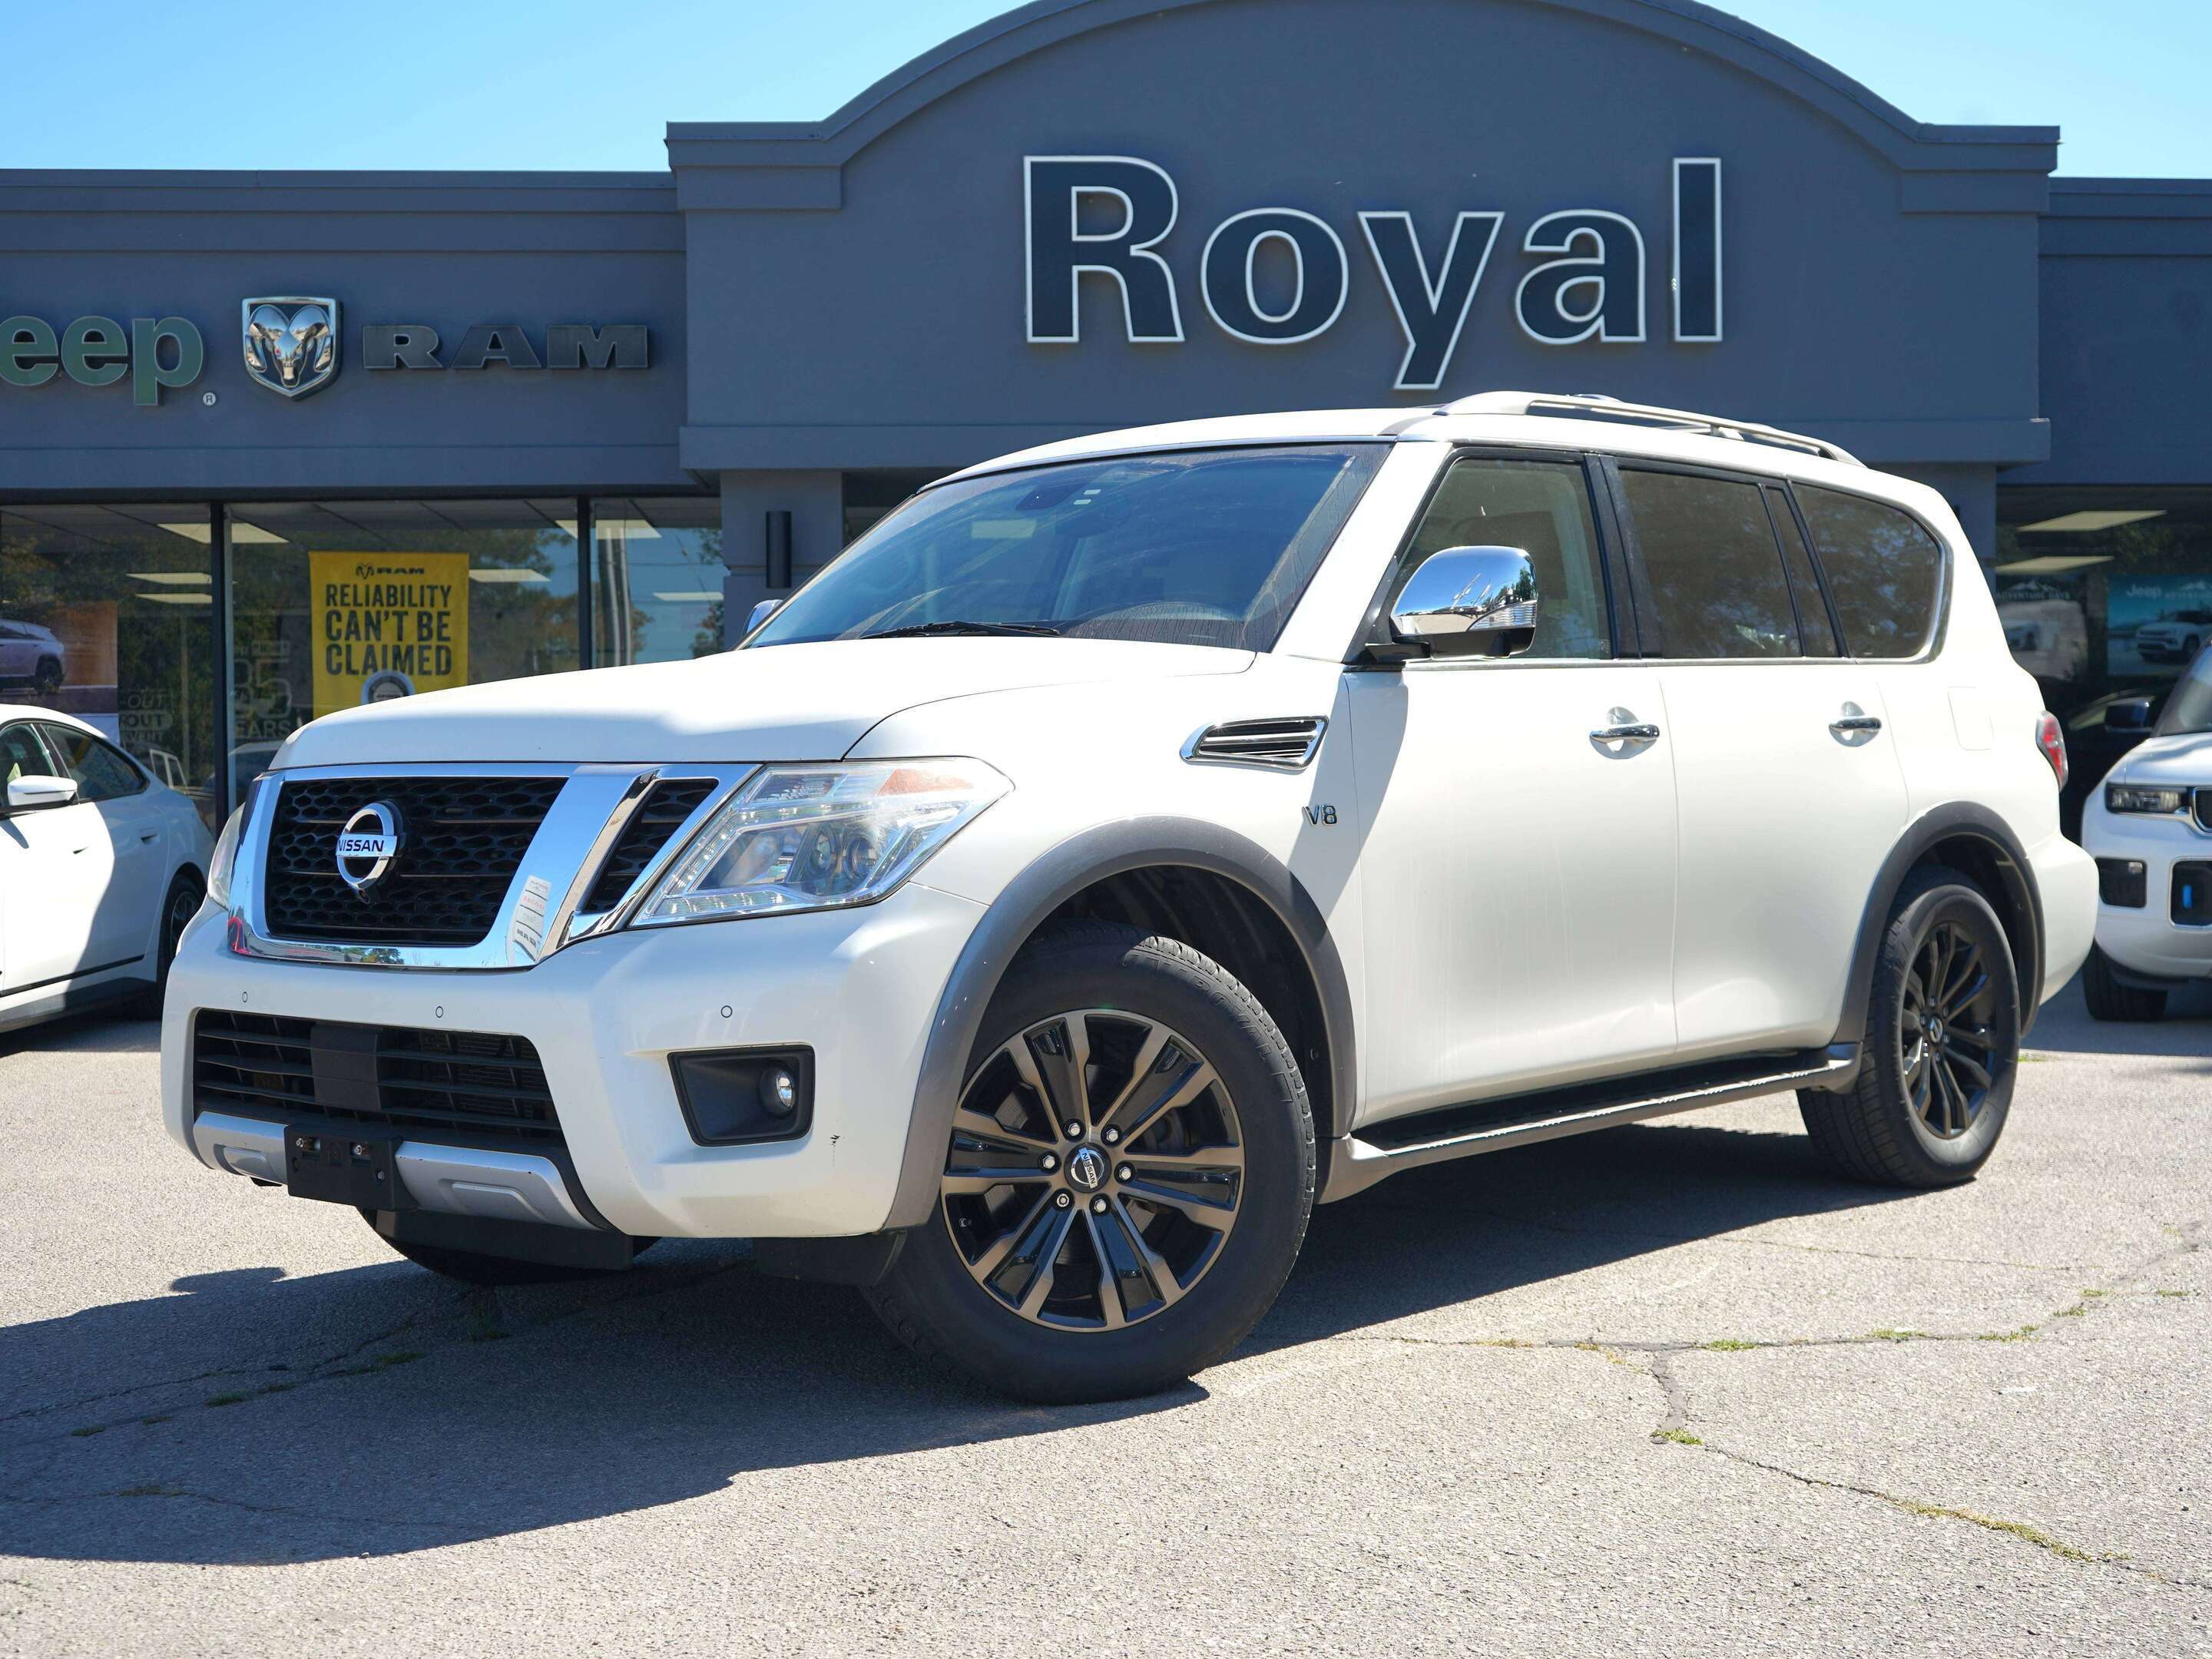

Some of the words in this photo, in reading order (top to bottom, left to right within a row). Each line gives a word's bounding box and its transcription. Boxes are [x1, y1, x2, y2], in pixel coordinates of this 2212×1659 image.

[1024, 155, 1722, 390] Royal
[363, 325, 648, 369] RAM
[326, 584, 452, 607] RELIABILITY
[2126, 584, 2162, 599] Jeep
[326, 609, 409, 641] CAN'T
[417, 611, 451, 641] BE
[326, 643, 452, 676] CLAIMED
[1302, 804, 1337, 826] V8
[338, 839, 384, 853] NISSAN
[1081, 1152, 1097, 1185] NISSAN
